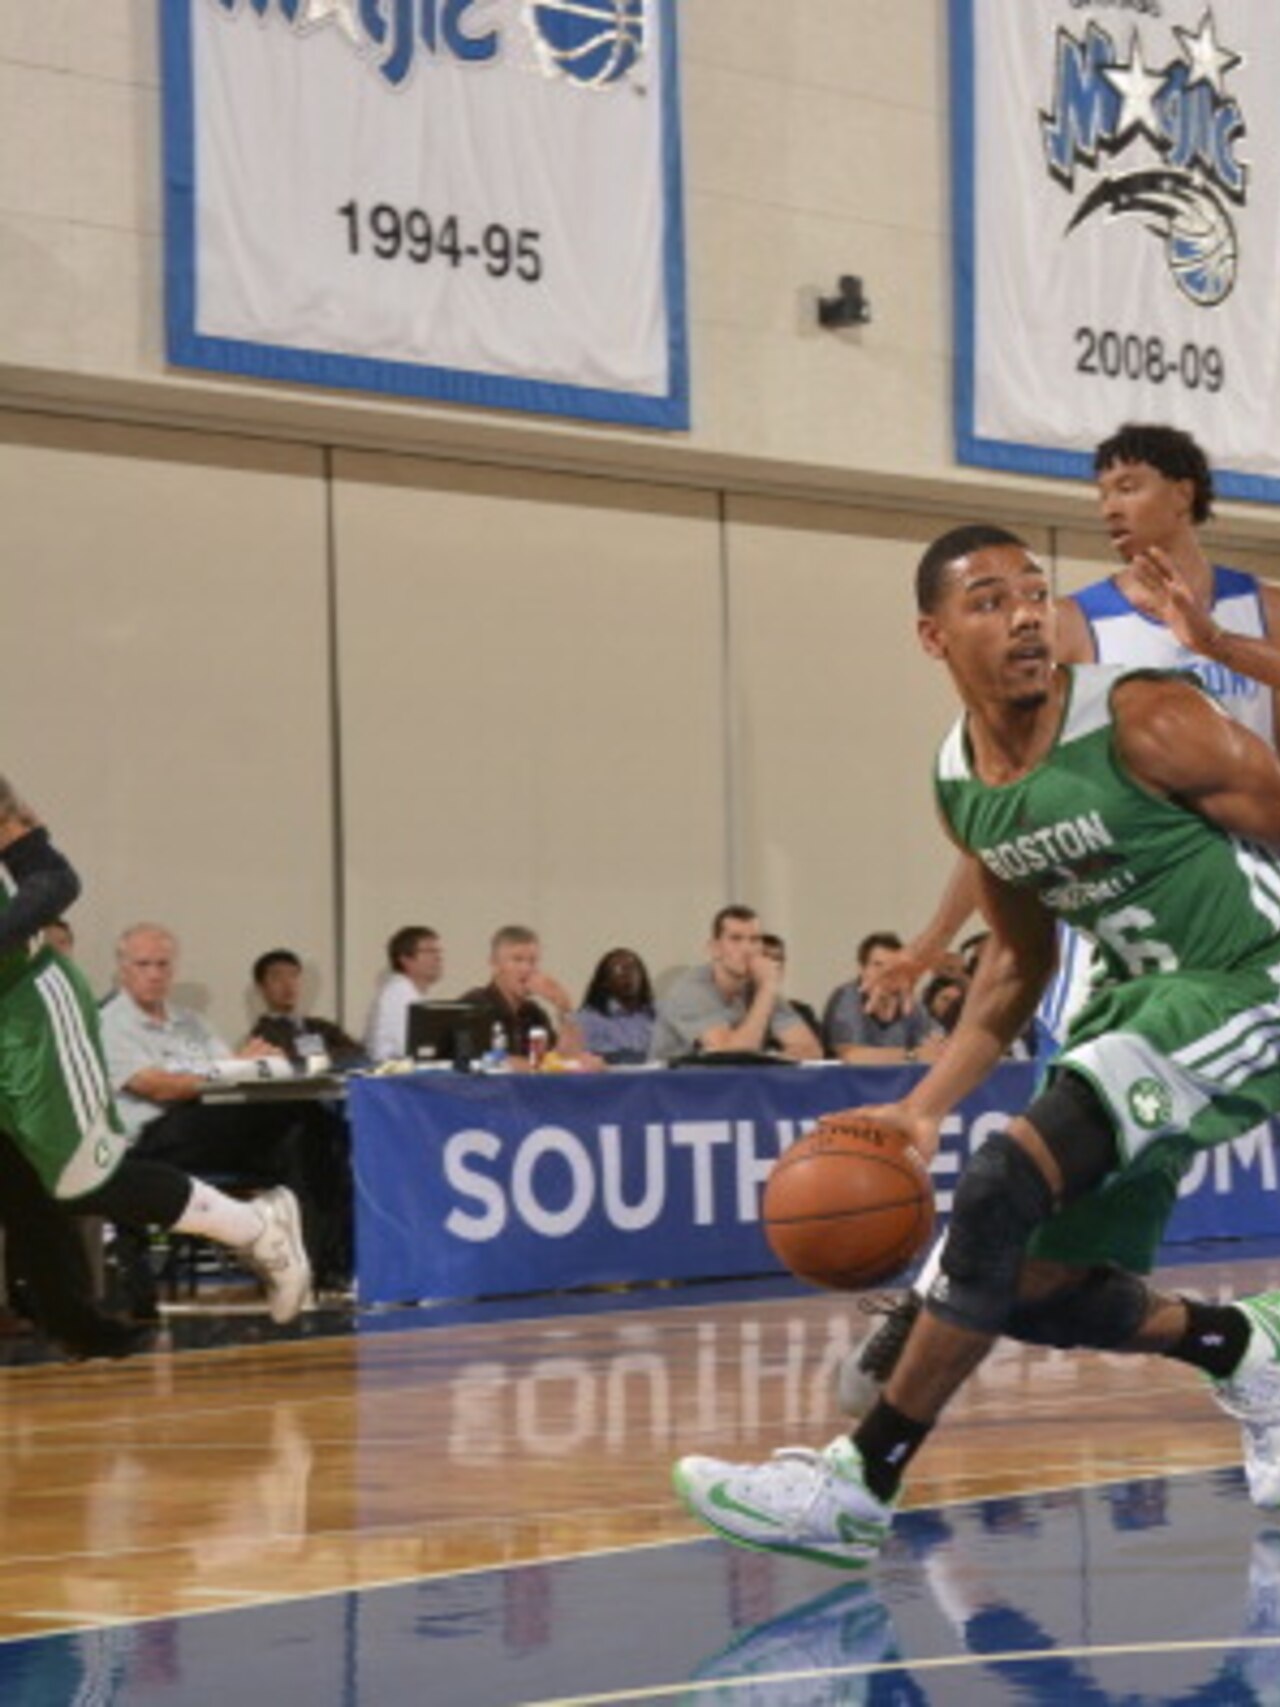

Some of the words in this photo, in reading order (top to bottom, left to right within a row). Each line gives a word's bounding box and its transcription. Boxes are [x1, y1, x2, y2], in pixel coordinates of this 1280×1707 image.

[337, 200, 542, 283] 1994-95
[1074, 327, 1224, 393] 2008-09
[980, 810, 1114, 881] BOSTON
